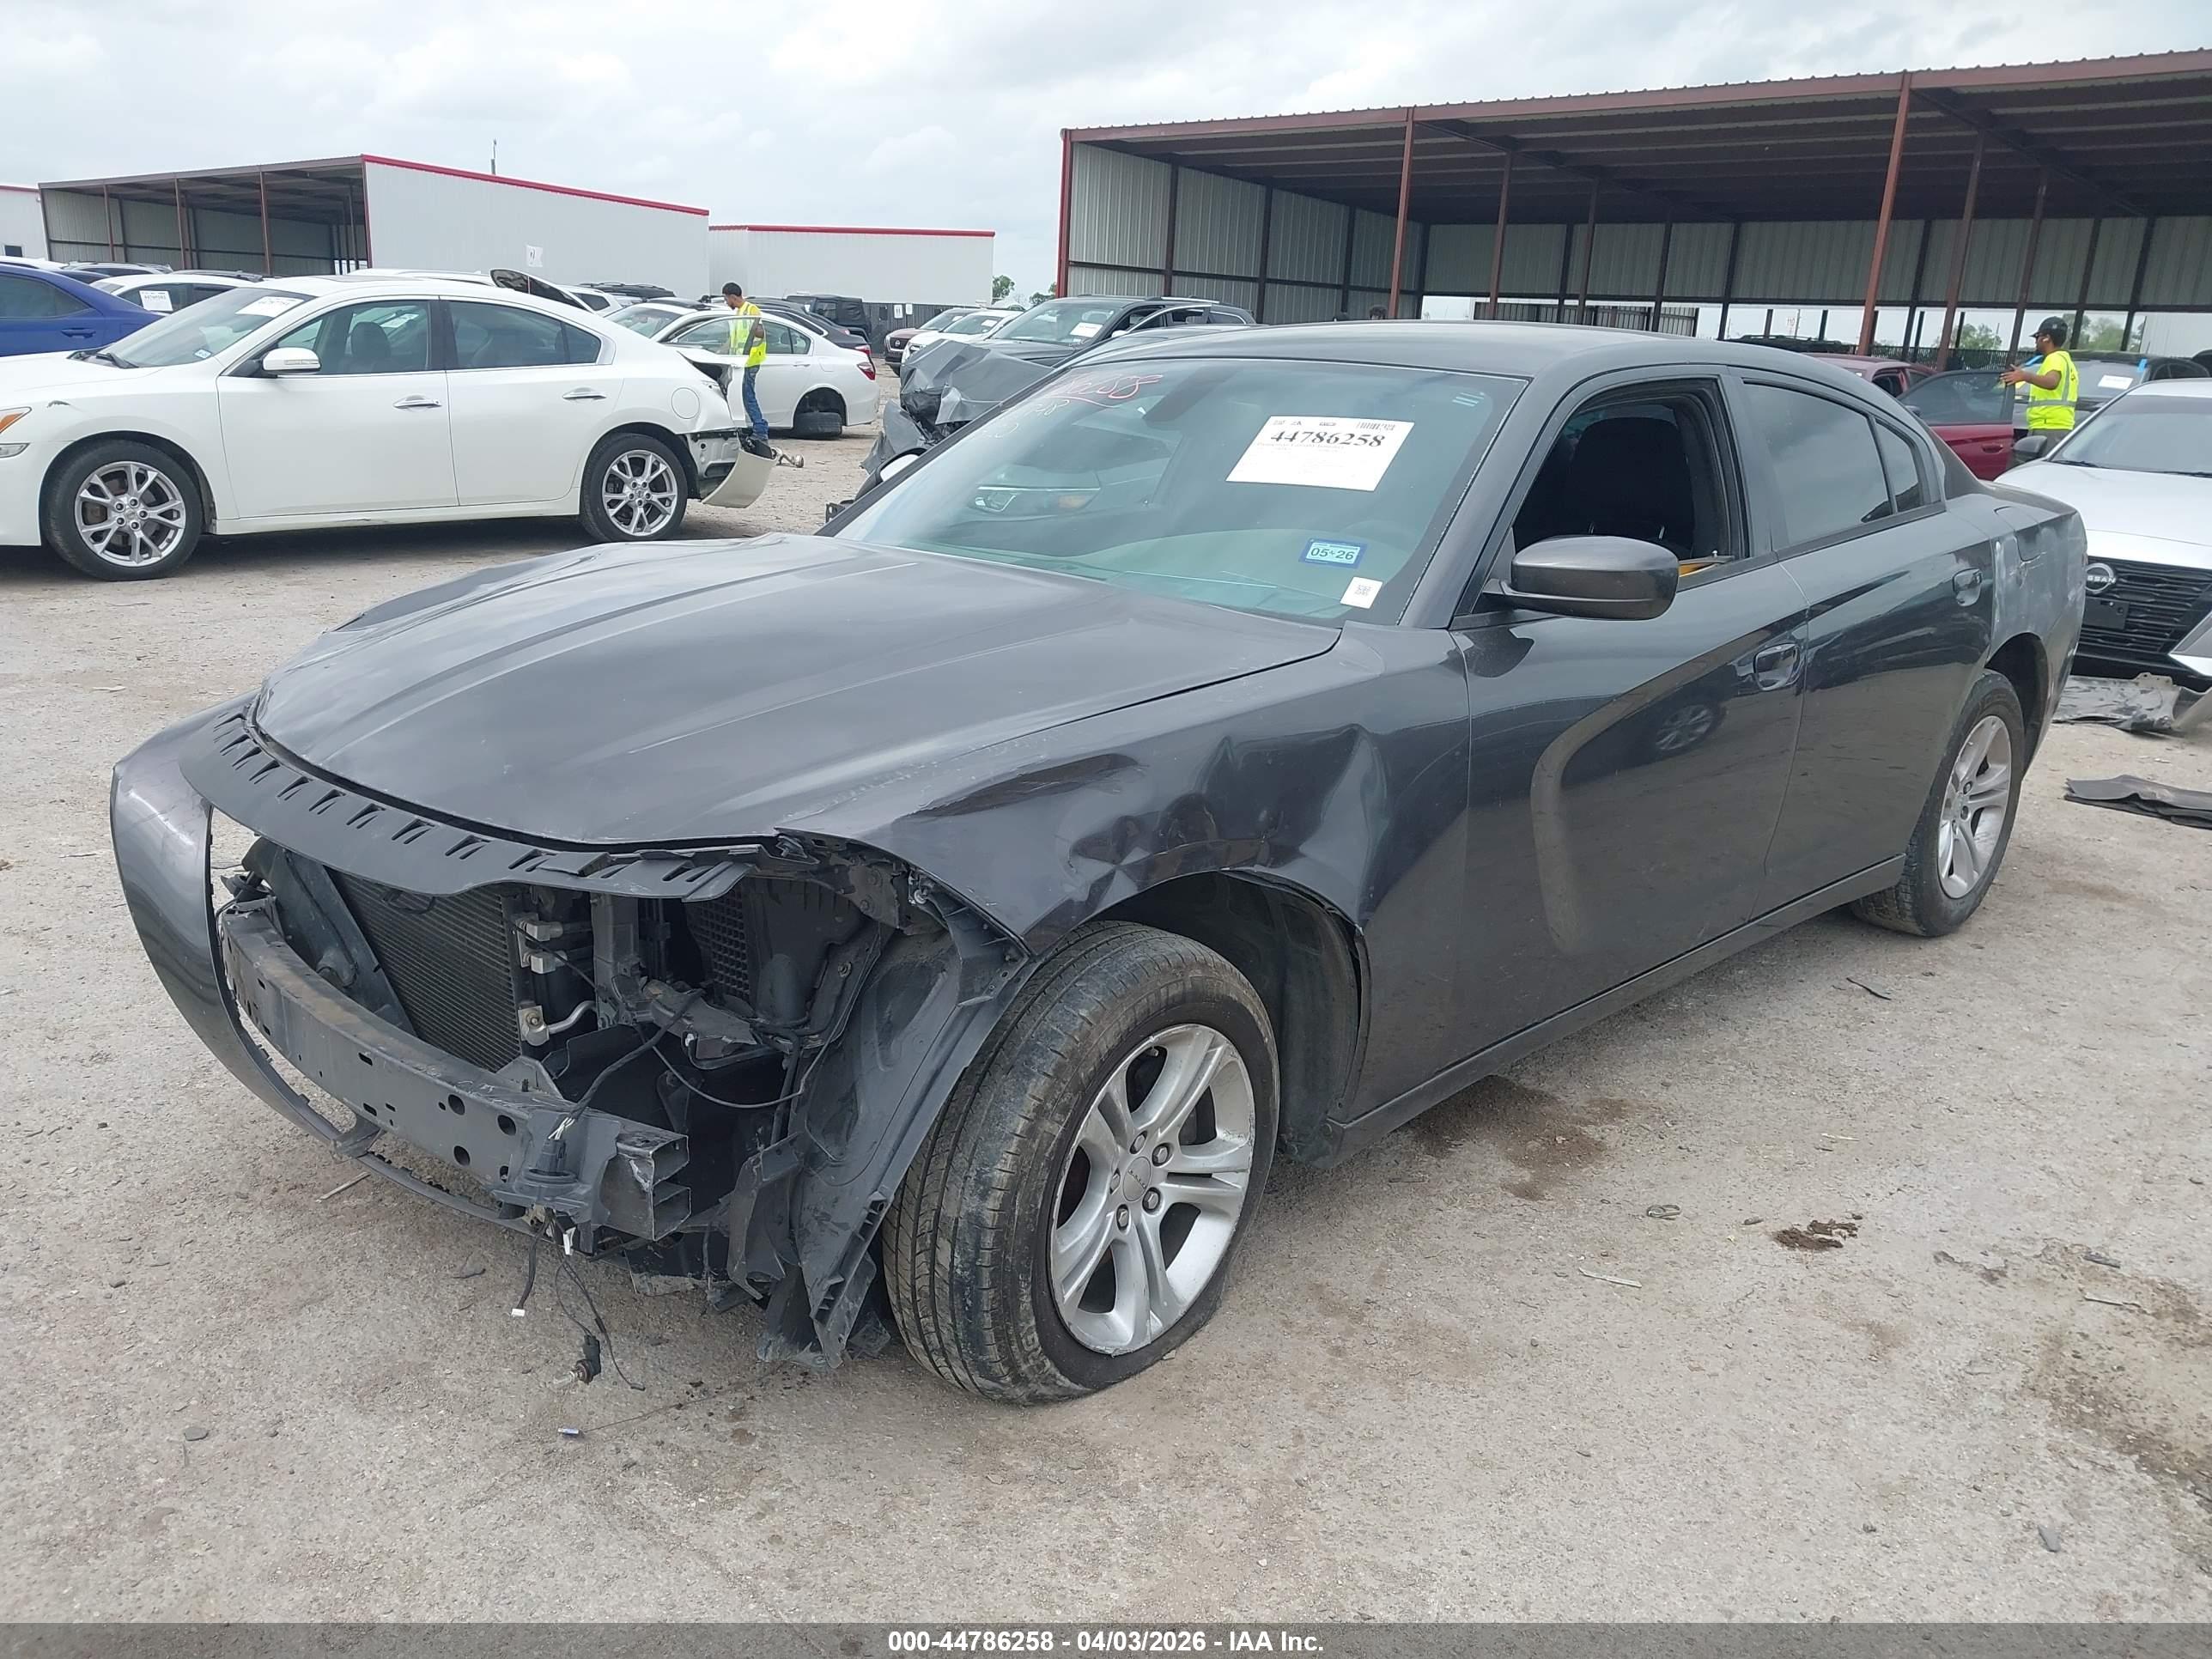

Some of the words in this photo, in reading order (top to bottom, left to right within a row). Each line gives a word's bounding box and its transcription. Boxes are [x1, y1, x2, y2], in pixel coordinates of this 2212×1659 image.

[1270, 430, 1386, 447] 44786258
[1310, 547, 1330, 557] 05
[1334, 550, 1355, 560] 26
[2087, 574, 2117, 584] SSAN
